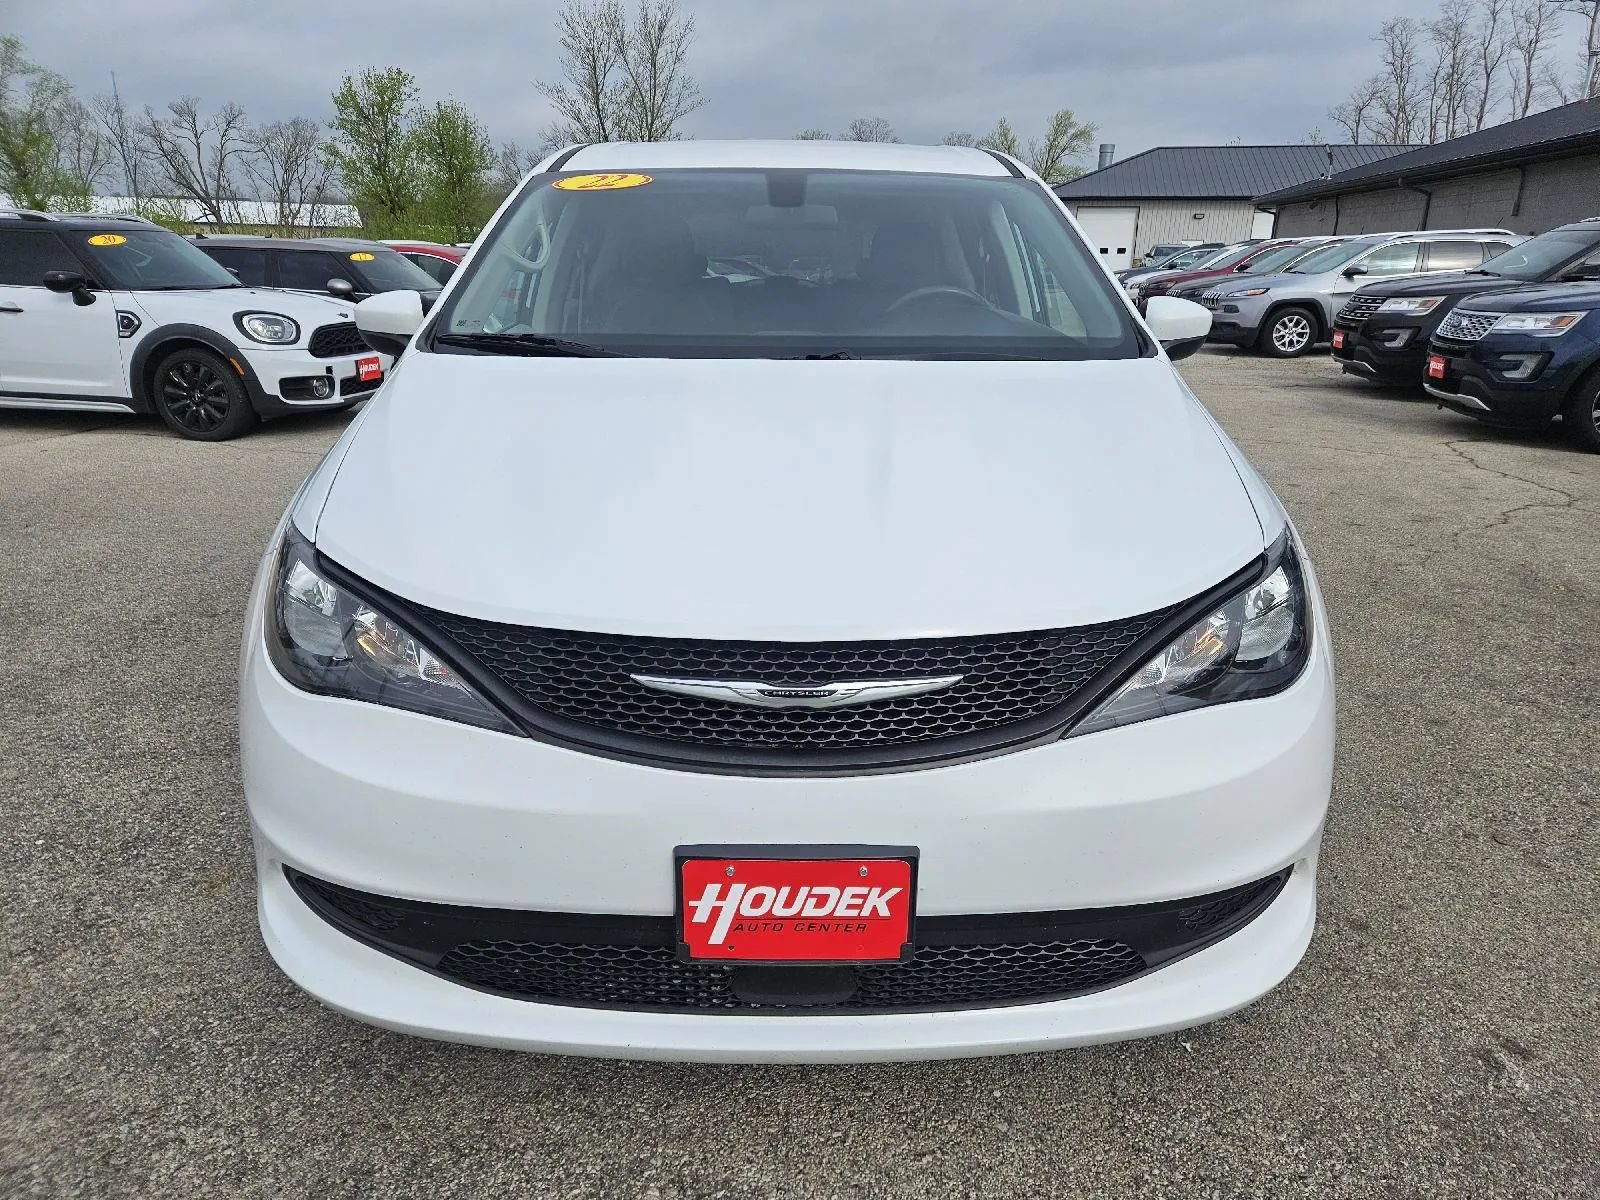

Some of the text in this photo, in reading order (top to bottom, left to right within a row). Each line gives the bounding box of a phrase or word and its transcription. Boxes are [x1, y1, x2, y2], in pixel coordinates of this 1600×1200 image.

[577, 175, 629, 188] 22
[689, 883, 903, 945] HOUDEK
[733, 922, 867, 932] AUTO CENTER
